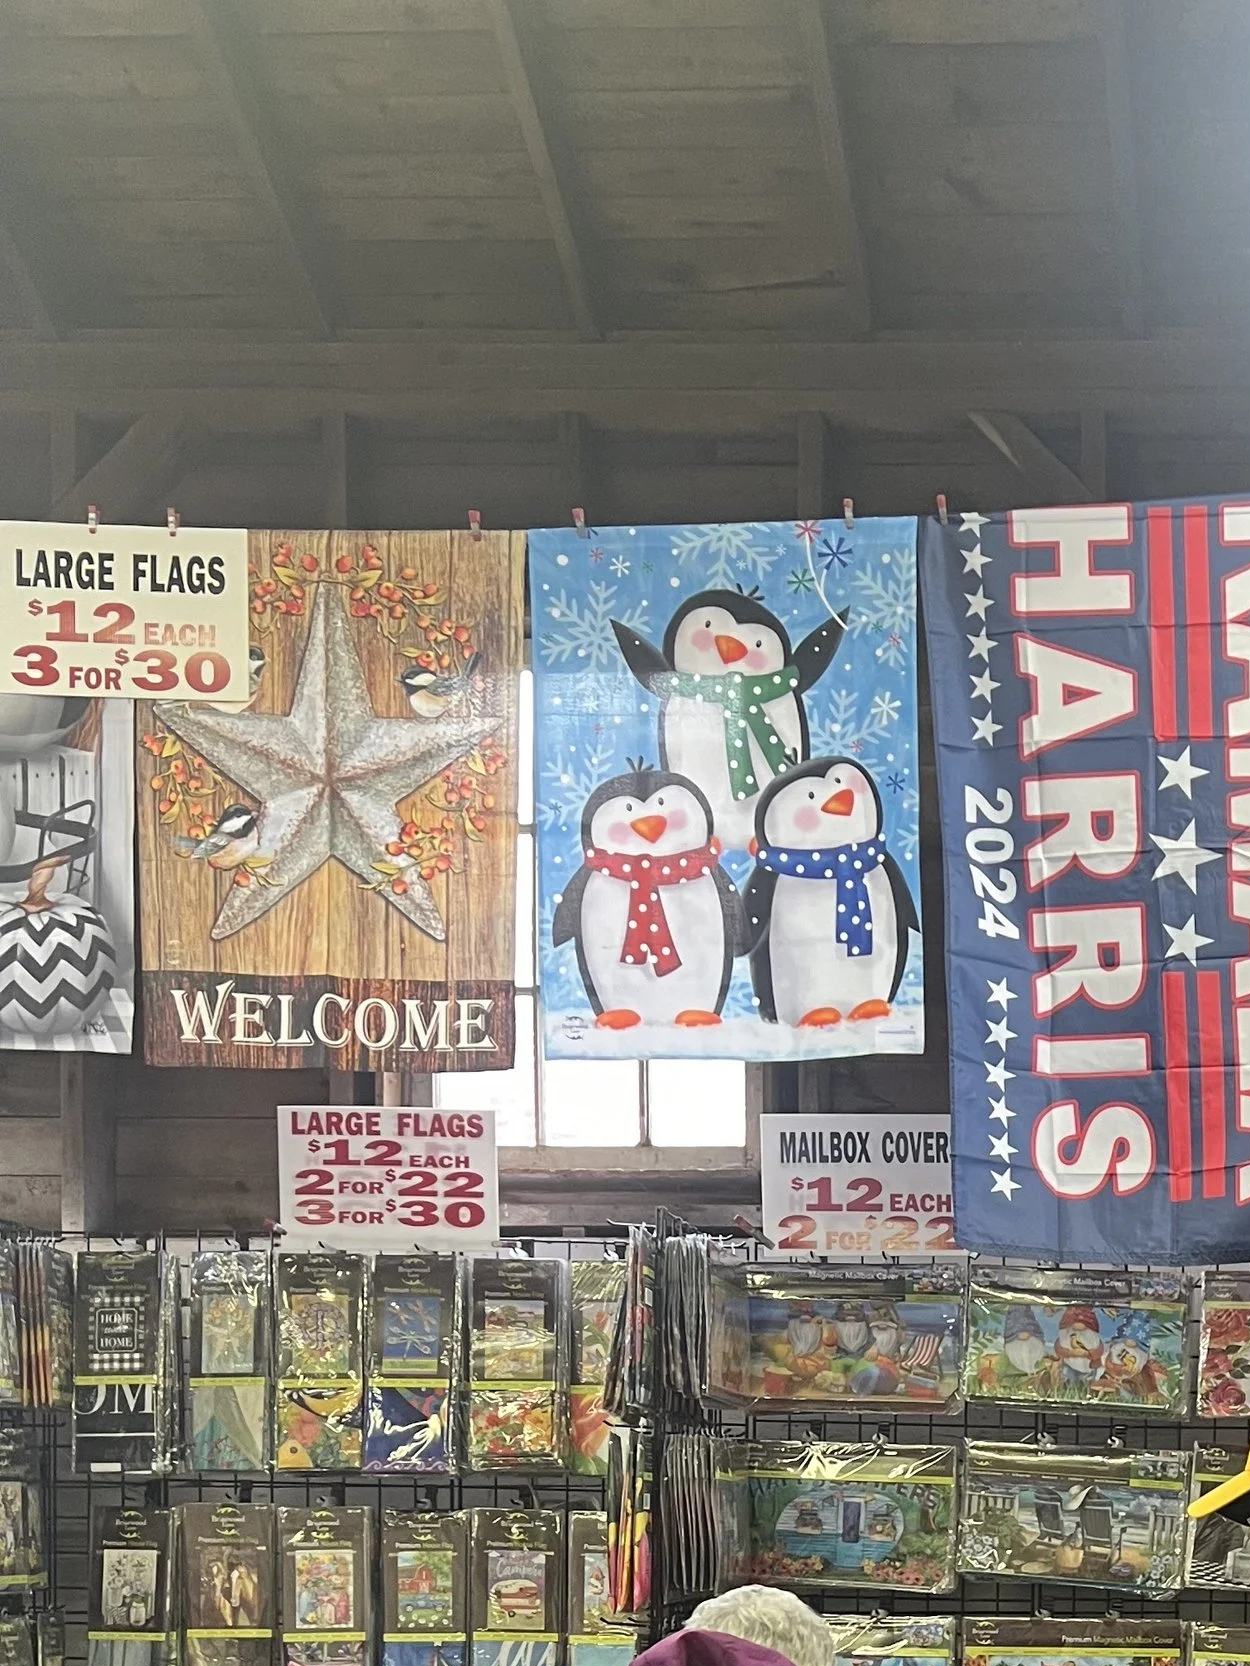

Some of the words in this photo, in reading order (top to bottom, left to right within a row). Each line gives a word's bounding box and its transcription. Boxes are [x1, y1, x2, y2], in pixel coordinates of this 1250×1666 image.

[16, 549, 114, 590] LARGE
[133, 554, 225, 595] FLAGS
[28, 599, 135, 644] $12
[144, 623, 216, 647] EACH
[11, 645, 60, 687] 3
[69, 666, 121, 690] FOR
[115, 648, 231, 693] $30
[963, 785, 1020, 938] 2024
[1007, 501, 1156, 1202] HARRIS
[170, 980, 498, 1053] WELCOME
[291, 1111, 381, 1136] LARGE
[397, 1113, 484, 1138] FLAGS
[308, 1139, 403, 1166] $12
[409, 1155, 470, 1168] EACH
[780, 1132, 871, 1164] MAILBOX
[882, 1131, 950, 1164] COVER
[295, 1169, 334, 1195] 2
[339, 1181, 384, 1194] FOR
[385, 1169, 484, 1198] $22
[791, 1177, 883, 1212] $12
[890, 1194, 951, 1212] EACH
[295, 1199, 335, 1225] 3
[339, 1211, 384, 1224] FOR
[385, 1199, 485, 1228] $30
[778, 1215, 817, 1249] 2
[826, 1232, 871, 1250] FOR
